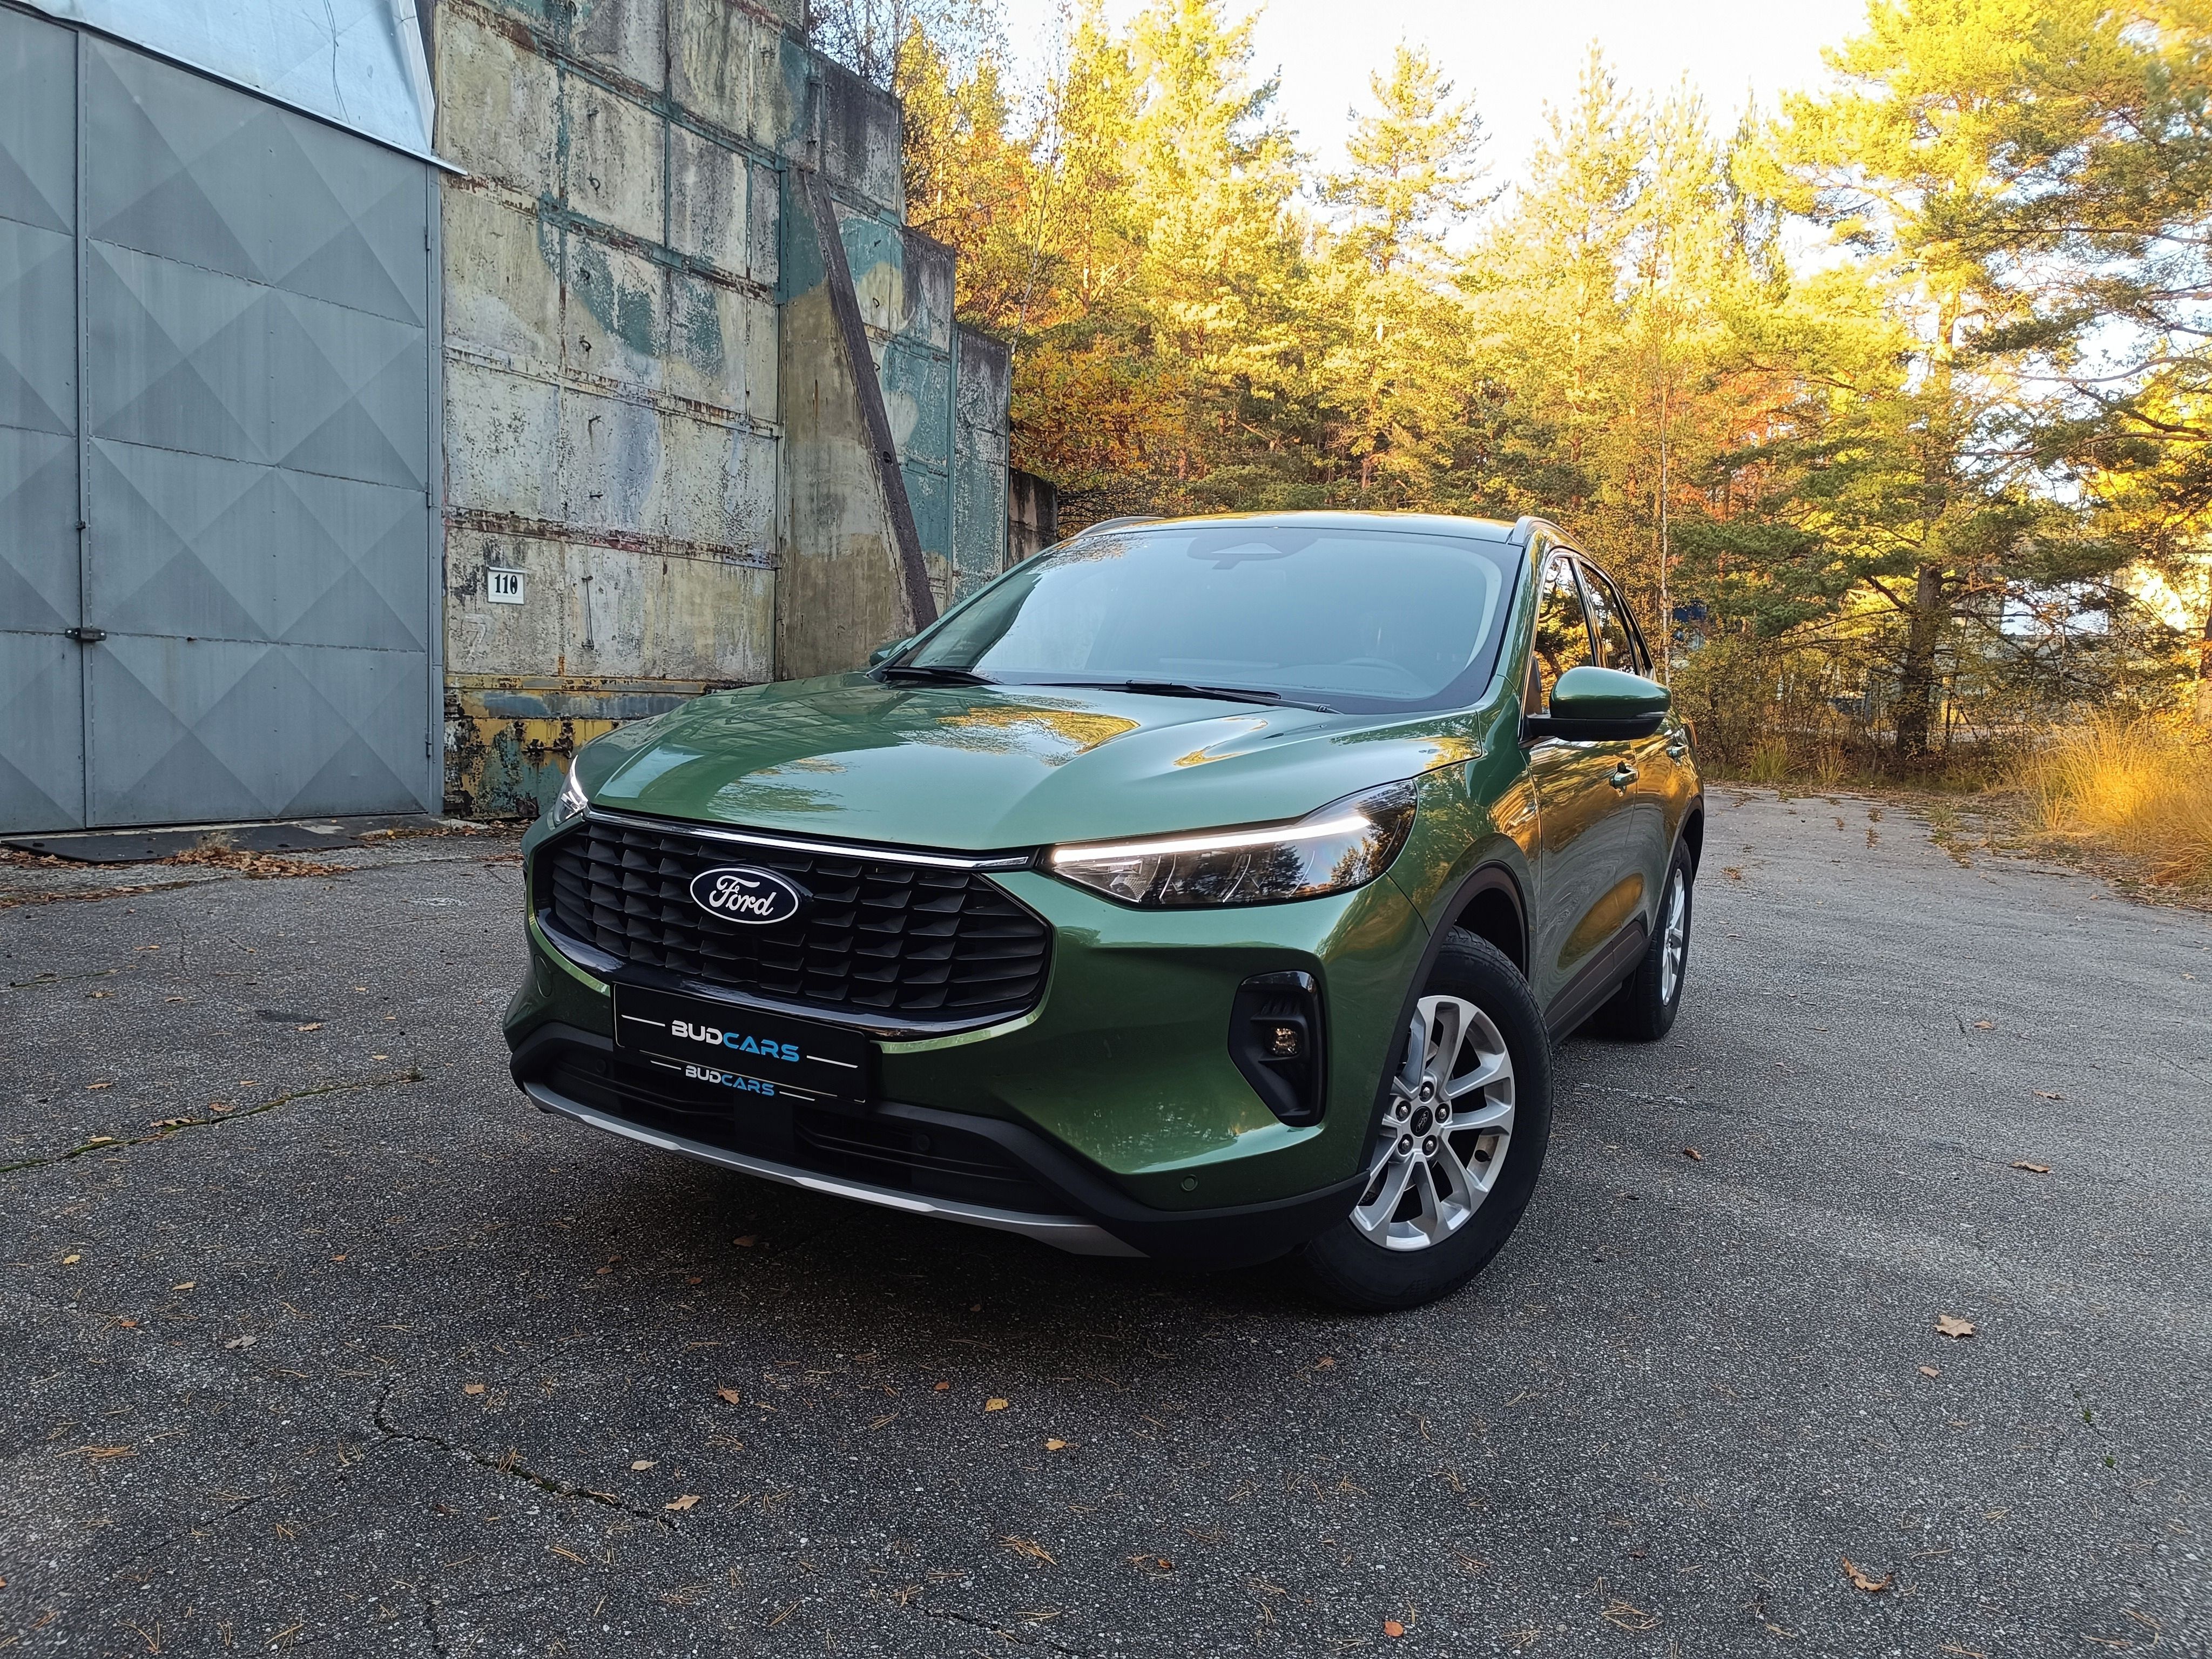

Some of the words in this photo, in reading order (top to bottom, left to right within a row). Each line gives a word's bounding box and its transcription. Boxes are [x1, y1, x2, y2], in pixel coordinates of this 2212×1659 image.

[494, 574, 518, 595] 110
[709, 875, 777, 916] Ford
[671, 1020, 800, 1062] BUDCARS
[685, 1065, 774, 1096] BUDCARS
